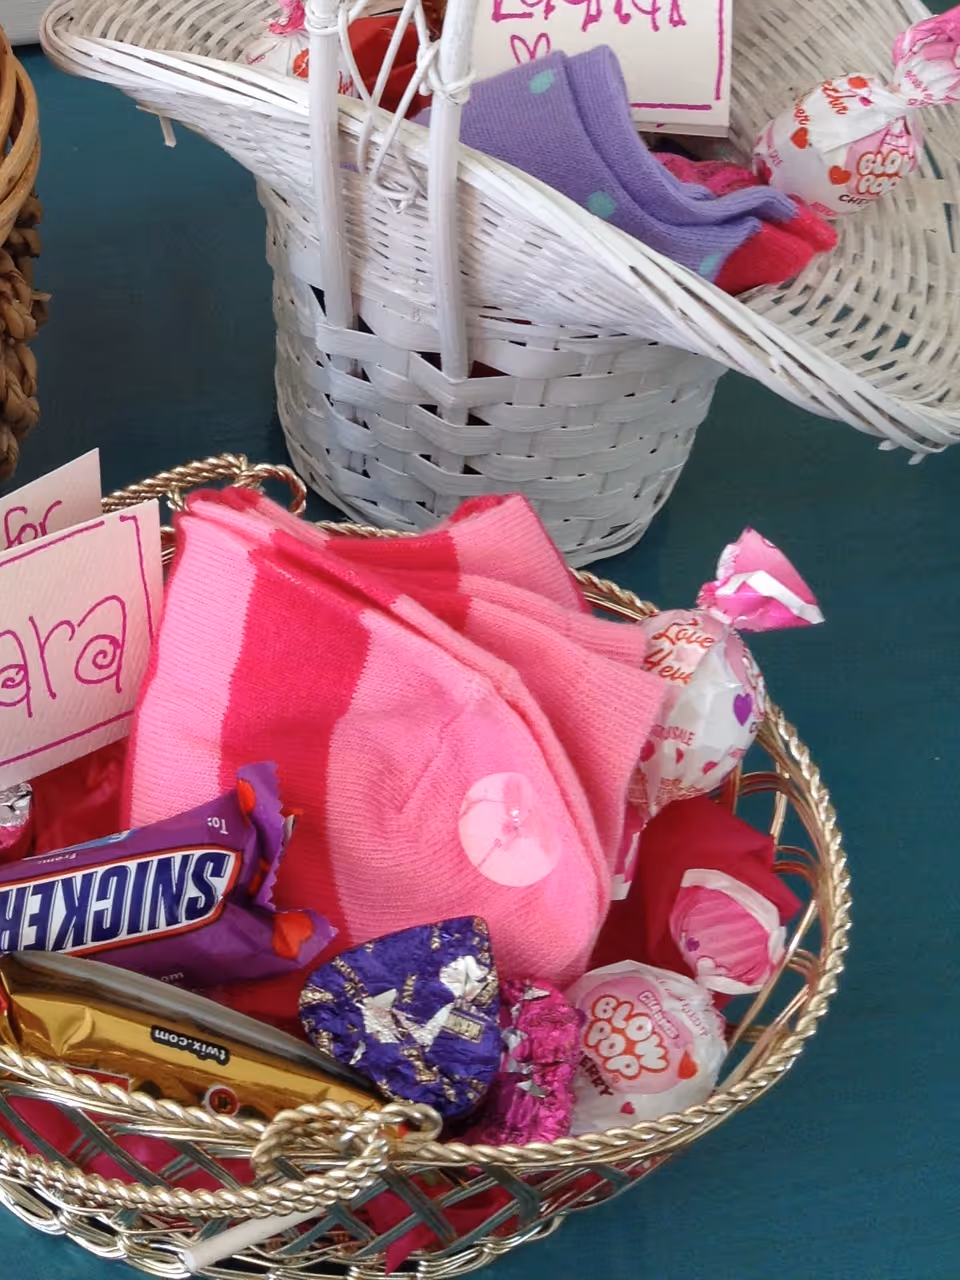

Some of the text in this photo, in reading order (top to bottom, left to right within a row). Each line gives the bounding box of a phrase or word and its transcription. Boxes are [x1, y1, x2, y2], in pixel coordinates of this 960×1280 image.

[206, 817, 229, 835] To:
[154, 1029, 227, 1061] twix.com
[585, 1020, 641, 1080] POP
[593, 994, 670, 1072] BLOW
